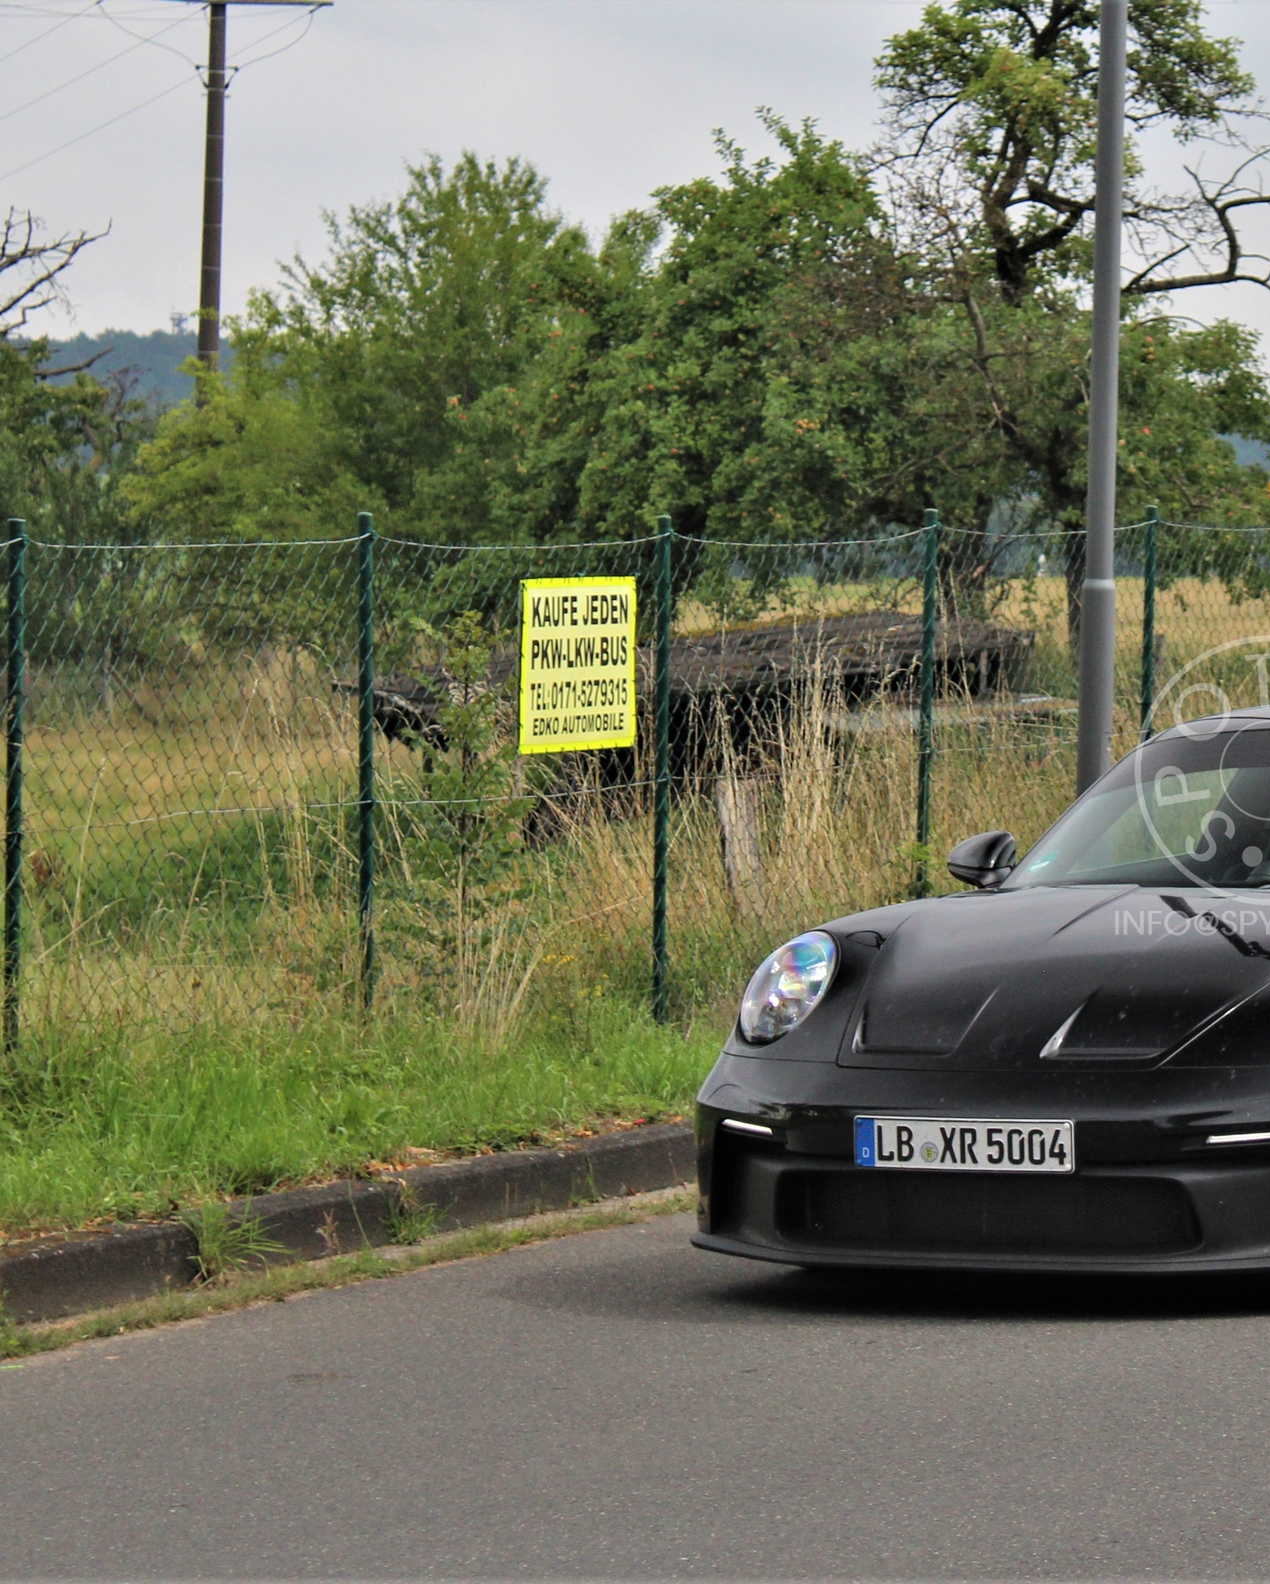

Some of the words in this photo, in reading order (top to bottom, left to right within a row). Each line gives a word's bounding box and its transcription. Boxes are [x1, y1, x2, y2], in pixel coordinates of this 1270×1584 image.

[532, 596, 578, 627] KAUFE
[583, 594, 628, 625] JEDEN
[531, 635, 627, 669] PKW-LKW-BUS
[533, 717, 559, 736] EDKO
[561, 712, 624, 734] AUTOMOBILE
[862, 1147, 870, 1158] D
[877, 1125, 914, 1161] LB
[940, 1127, 978, 1164] XR
[987, 1128, 1067, 1165] 5004
